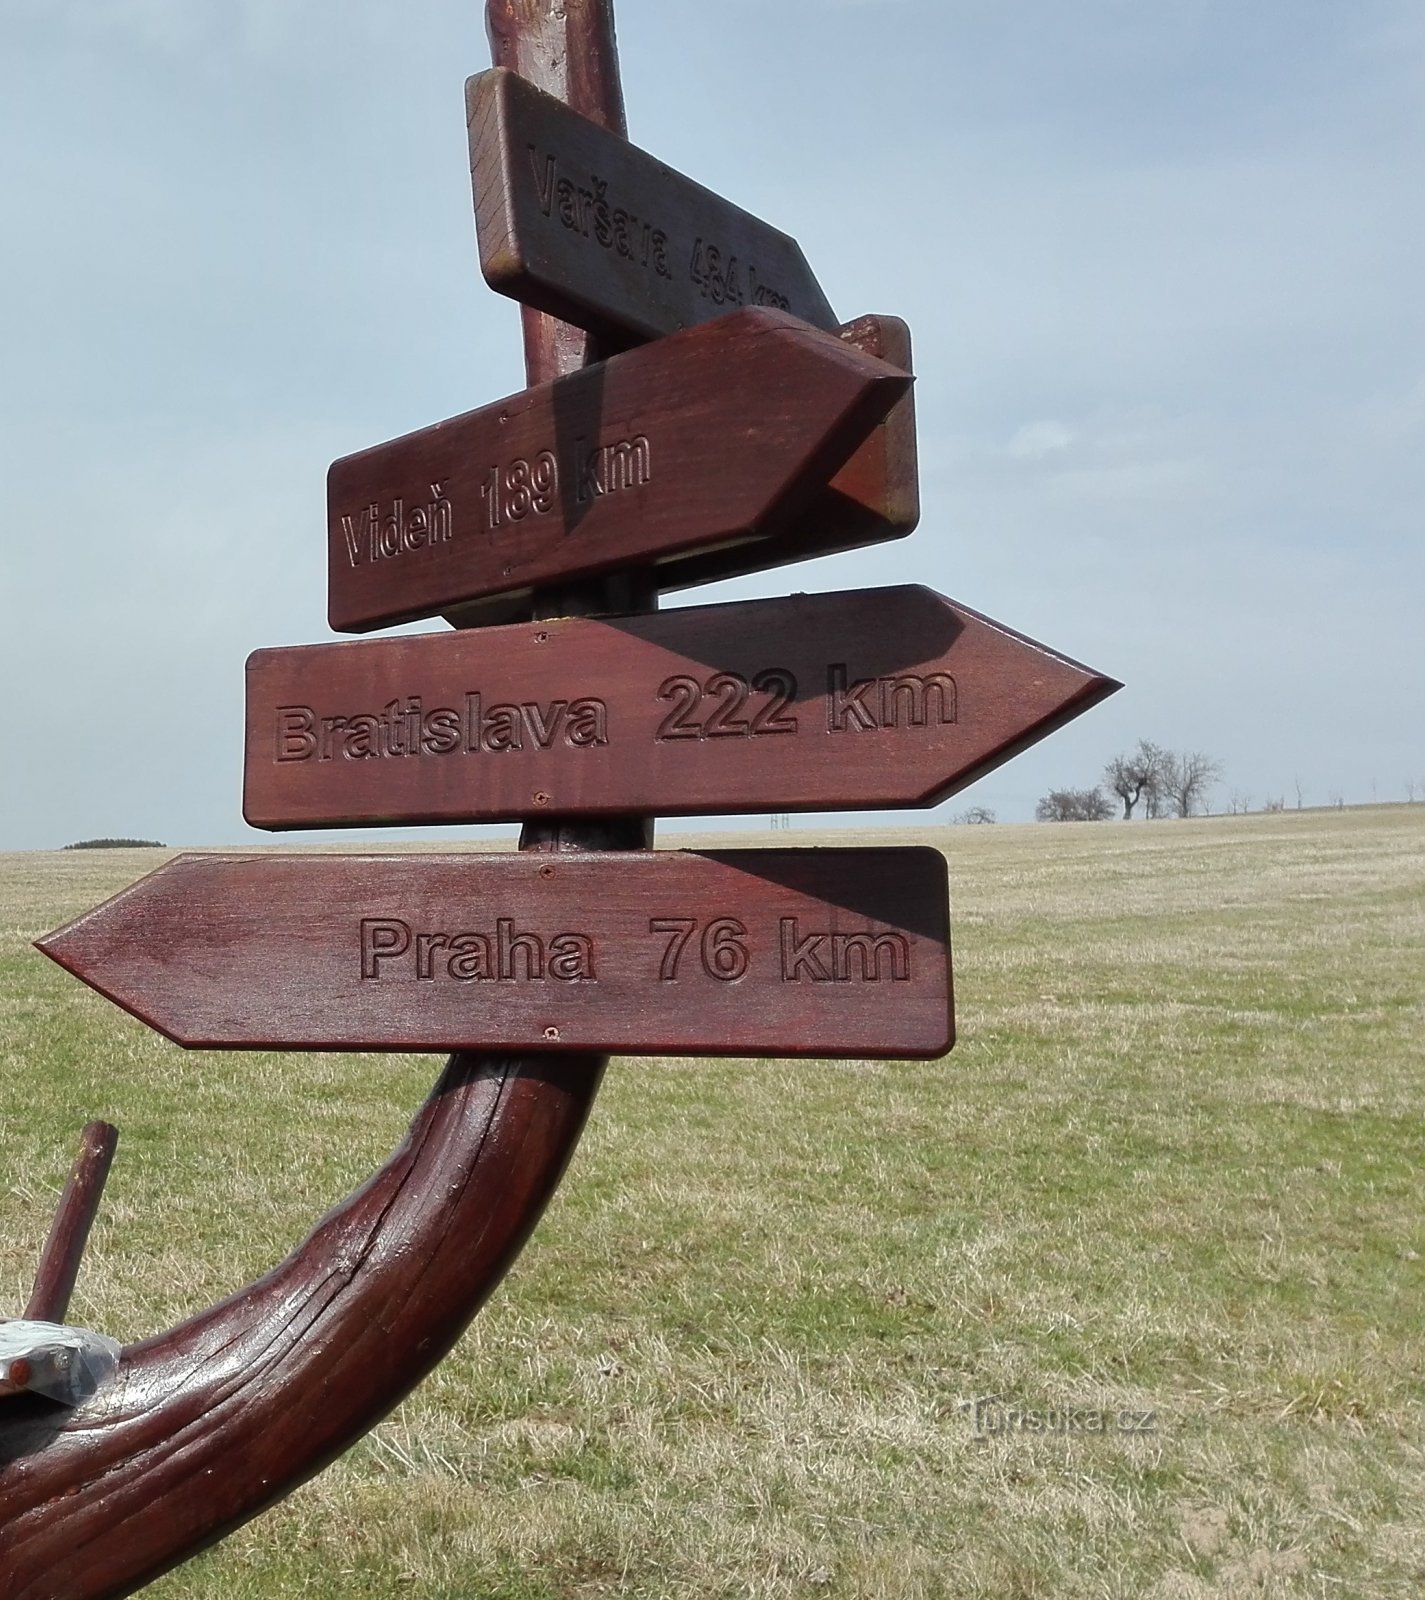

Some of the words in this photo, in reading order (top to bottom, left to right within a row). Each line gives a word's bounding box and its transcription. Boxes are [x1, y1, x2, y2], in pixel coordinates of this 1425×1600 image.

[527, 144, 672, 281] Varšava
[480, 449, 559, 530] 189
[574, 433, 652, 502] km
[274, 690, 610, 764] Bratislava
[653, 665, 799, 746] 222
[825, 661, 958, 735] km
[359, 916, 597, 985] Praha
[648, 916, 751, 985] 76
[779, 916, 911, 984] km
